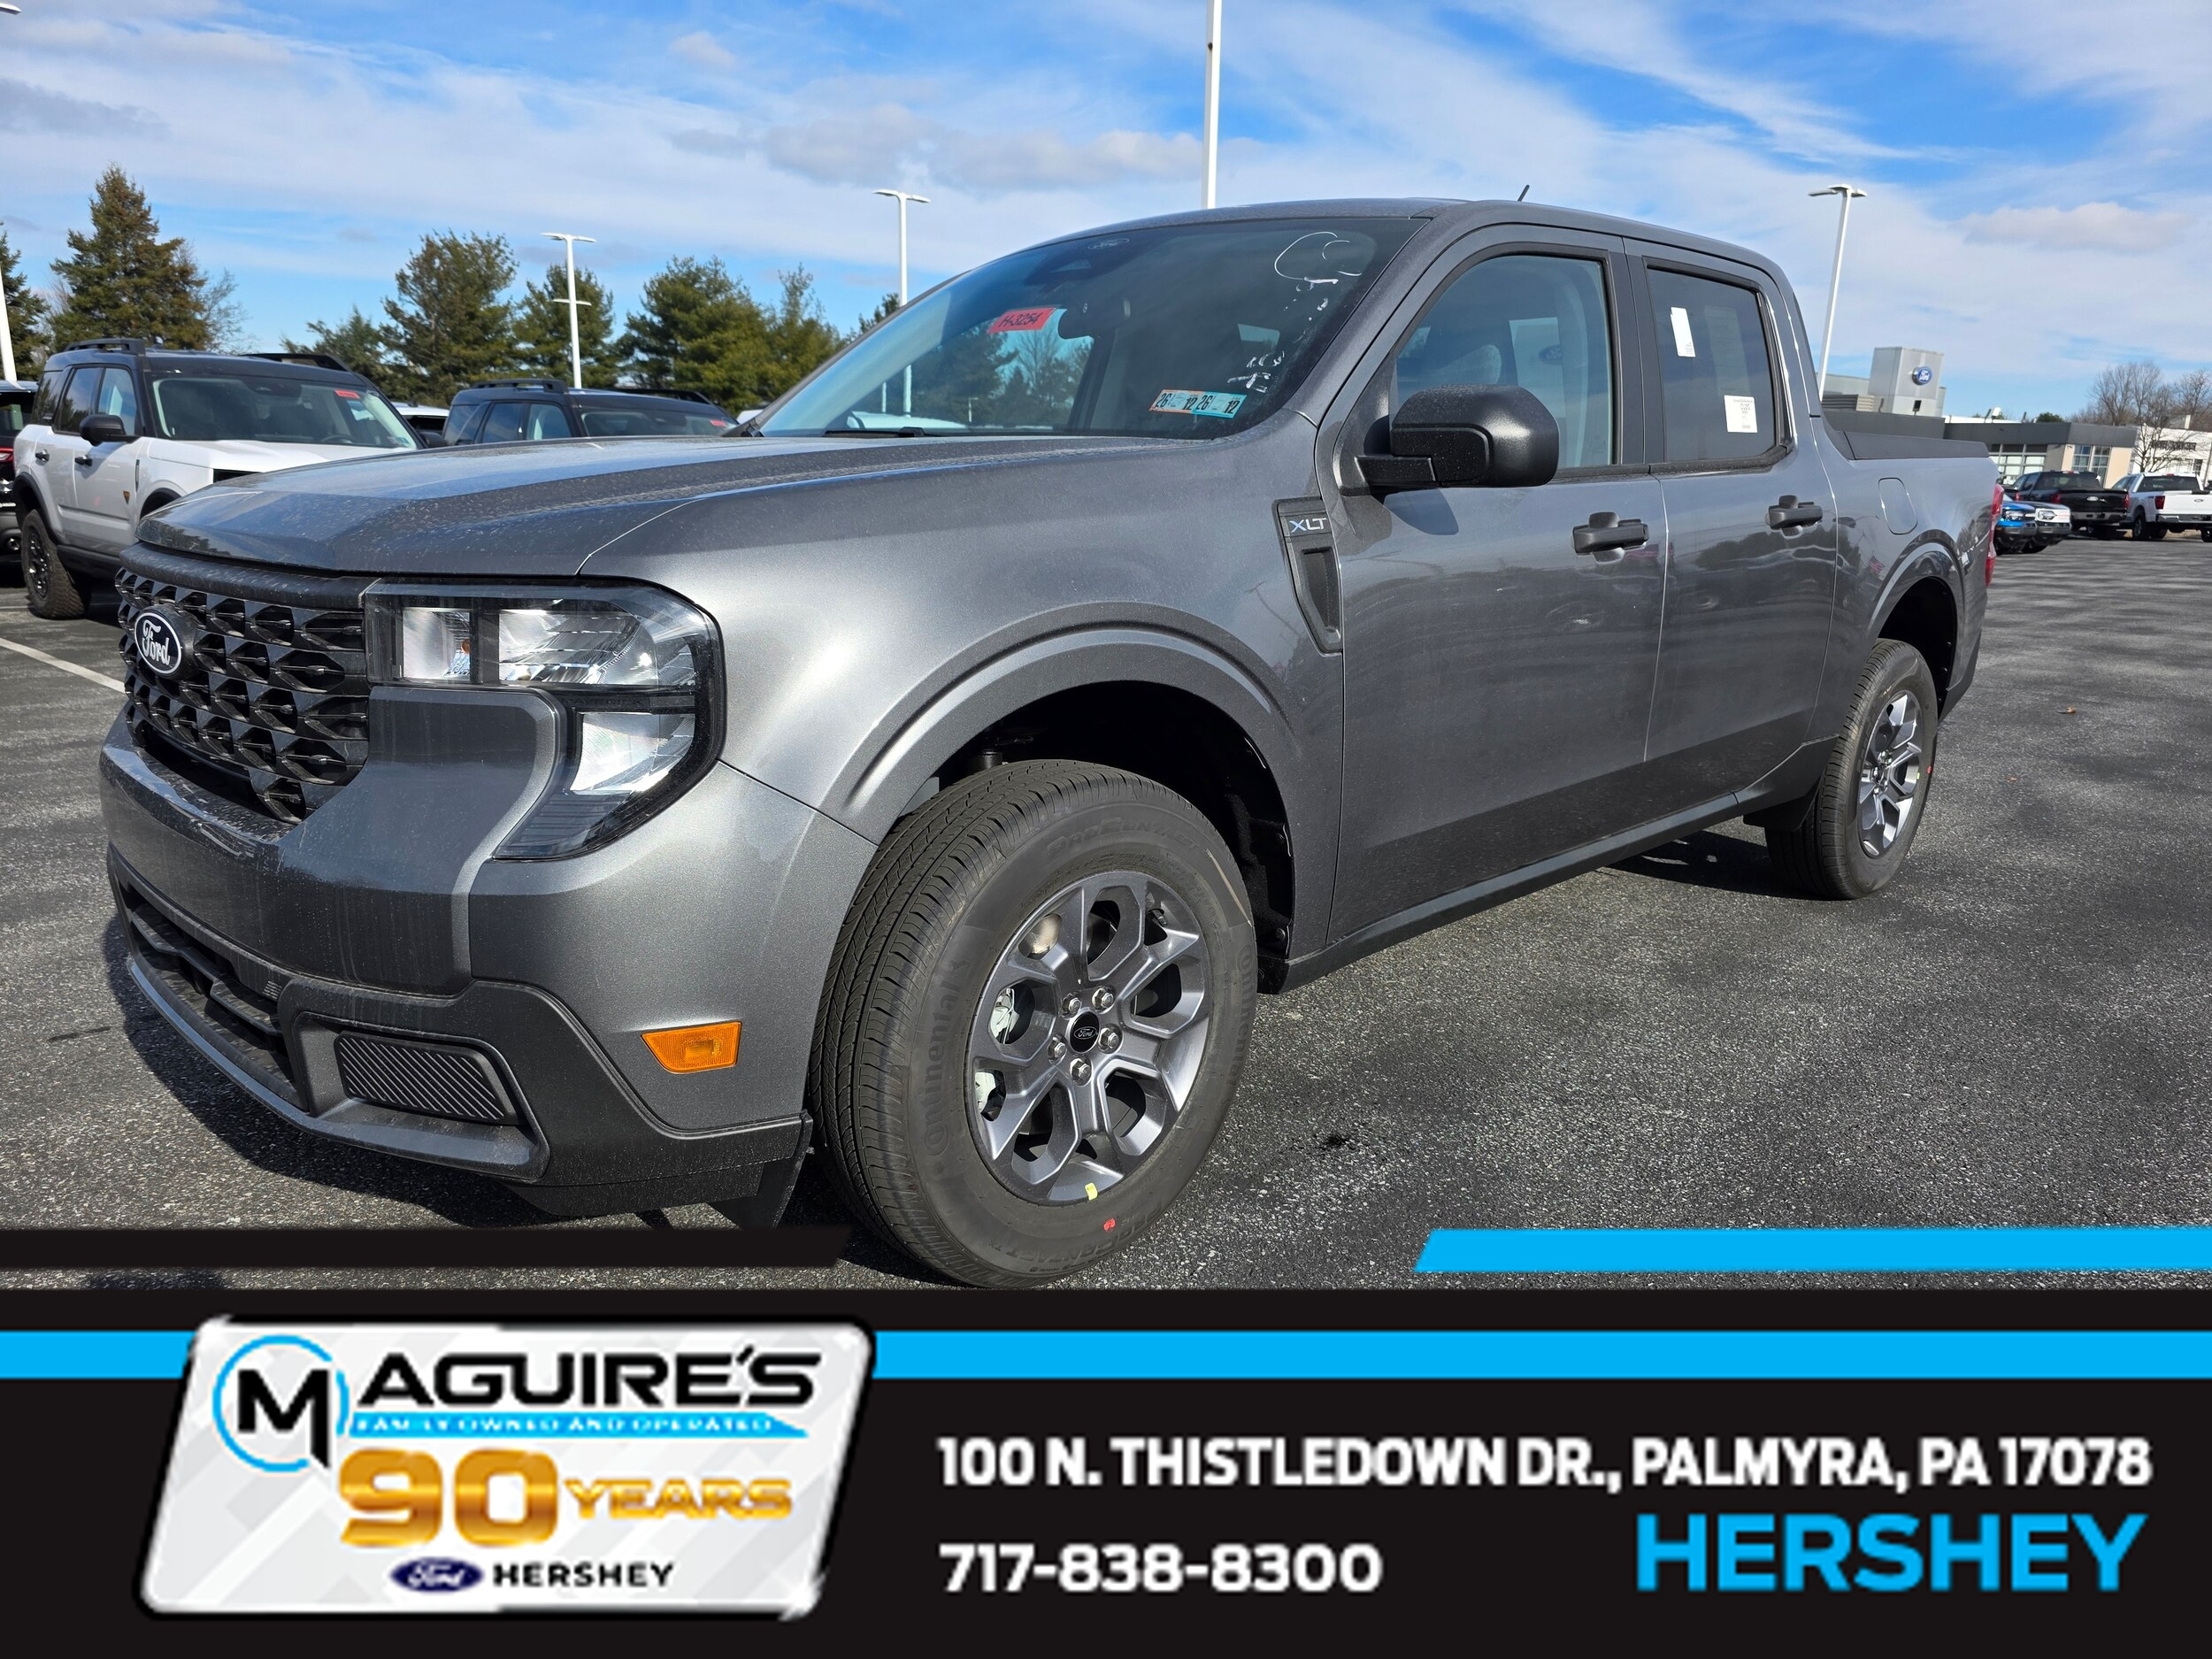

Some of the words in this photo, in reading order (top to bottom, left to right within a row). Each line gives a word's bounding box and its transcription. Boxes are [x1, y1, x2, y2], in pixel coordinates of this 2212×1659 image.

[1156, 393, 1172, 408] 26
[1183, 397, 1198, 411] 12
[1196, 395, 1213, 411] 26
[1224, 400, 1240, 414] 12
[1289, 518, 1327, 533] XLT
[142, 619, 171, 665] Ford
